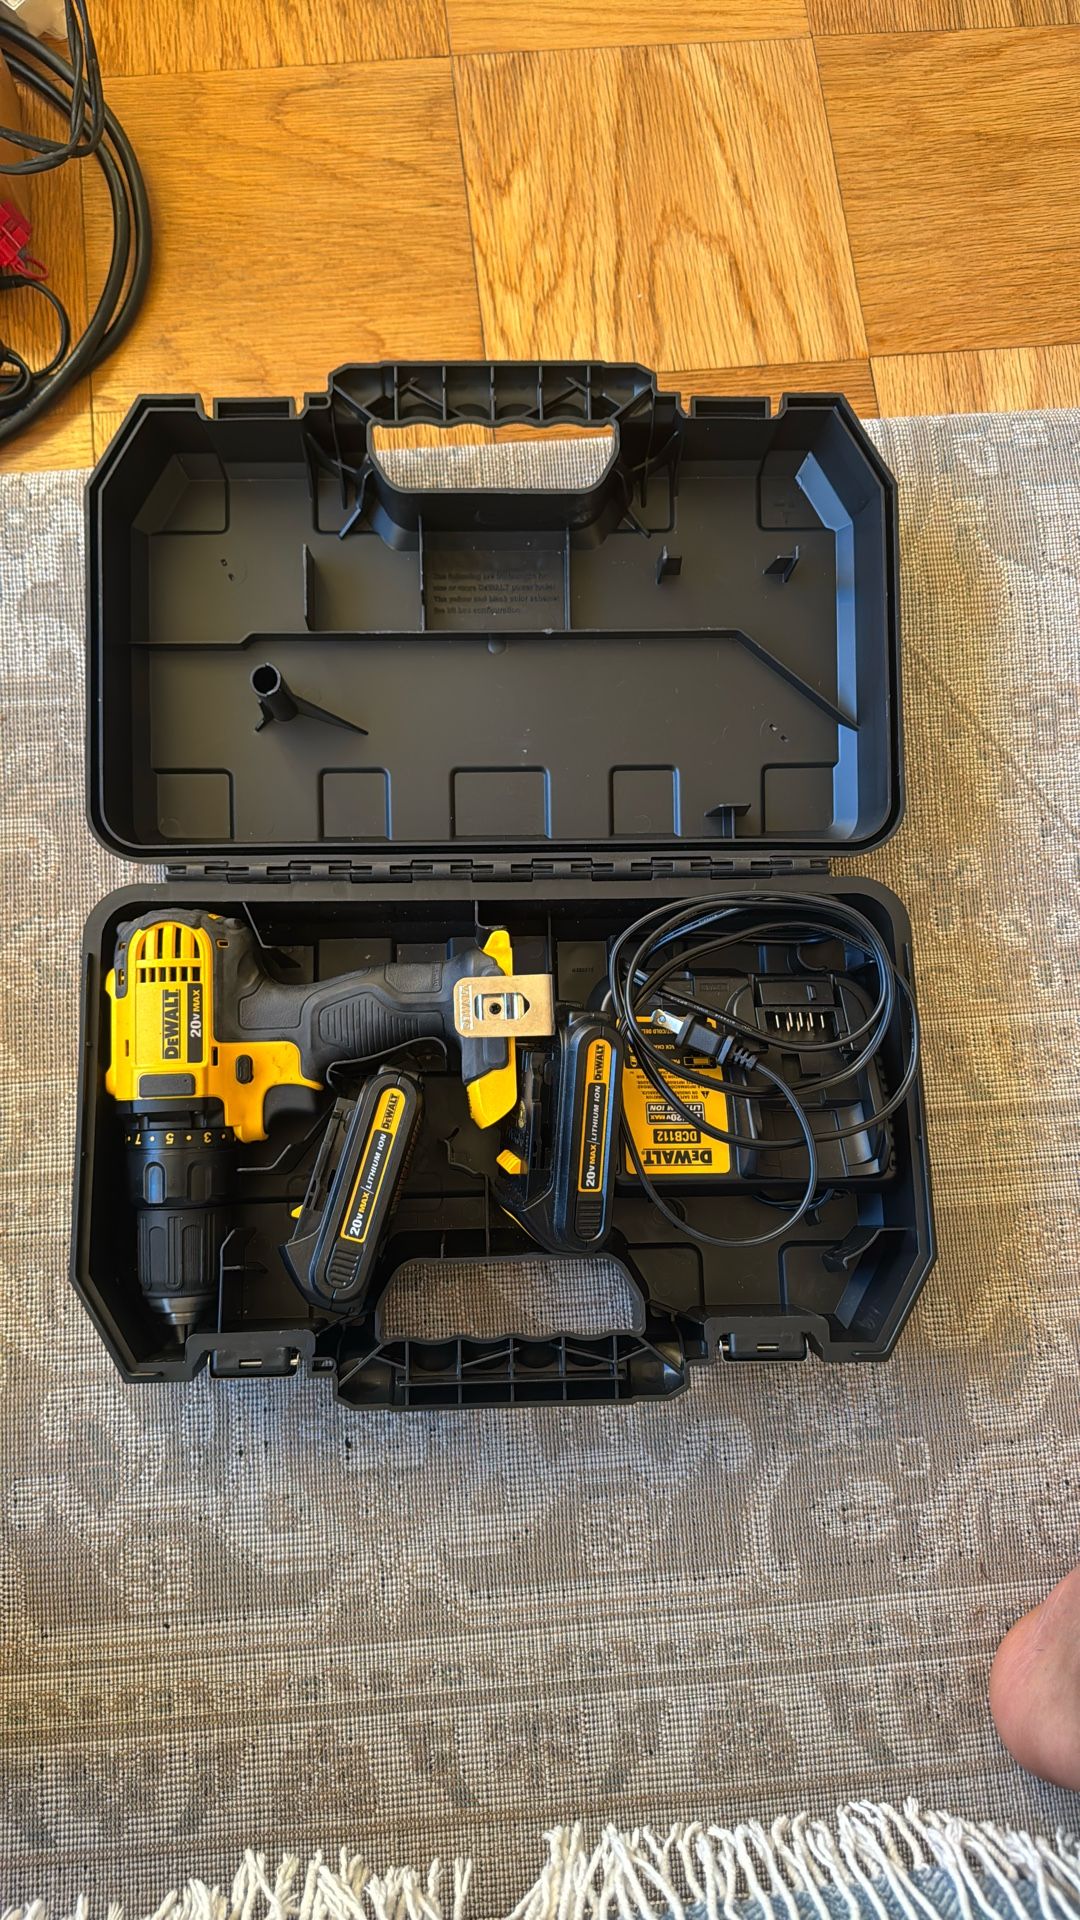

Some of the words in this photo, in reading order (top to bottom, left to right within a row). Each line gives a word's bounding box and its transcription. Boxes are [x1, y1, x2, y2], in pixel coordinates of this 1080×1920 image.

[193, 989, 201, 1012] MAX
[590, 1104, 600, 1141] LITHIUM
[165, 1132, 174, 1145] 5
[203, 1131, 212, 1143] 3
[657, 1130, 698, 1142] DCB112
[366, 1152, 381, 1189] LITHIUM
[377, 1133, 387, 1151] ION
